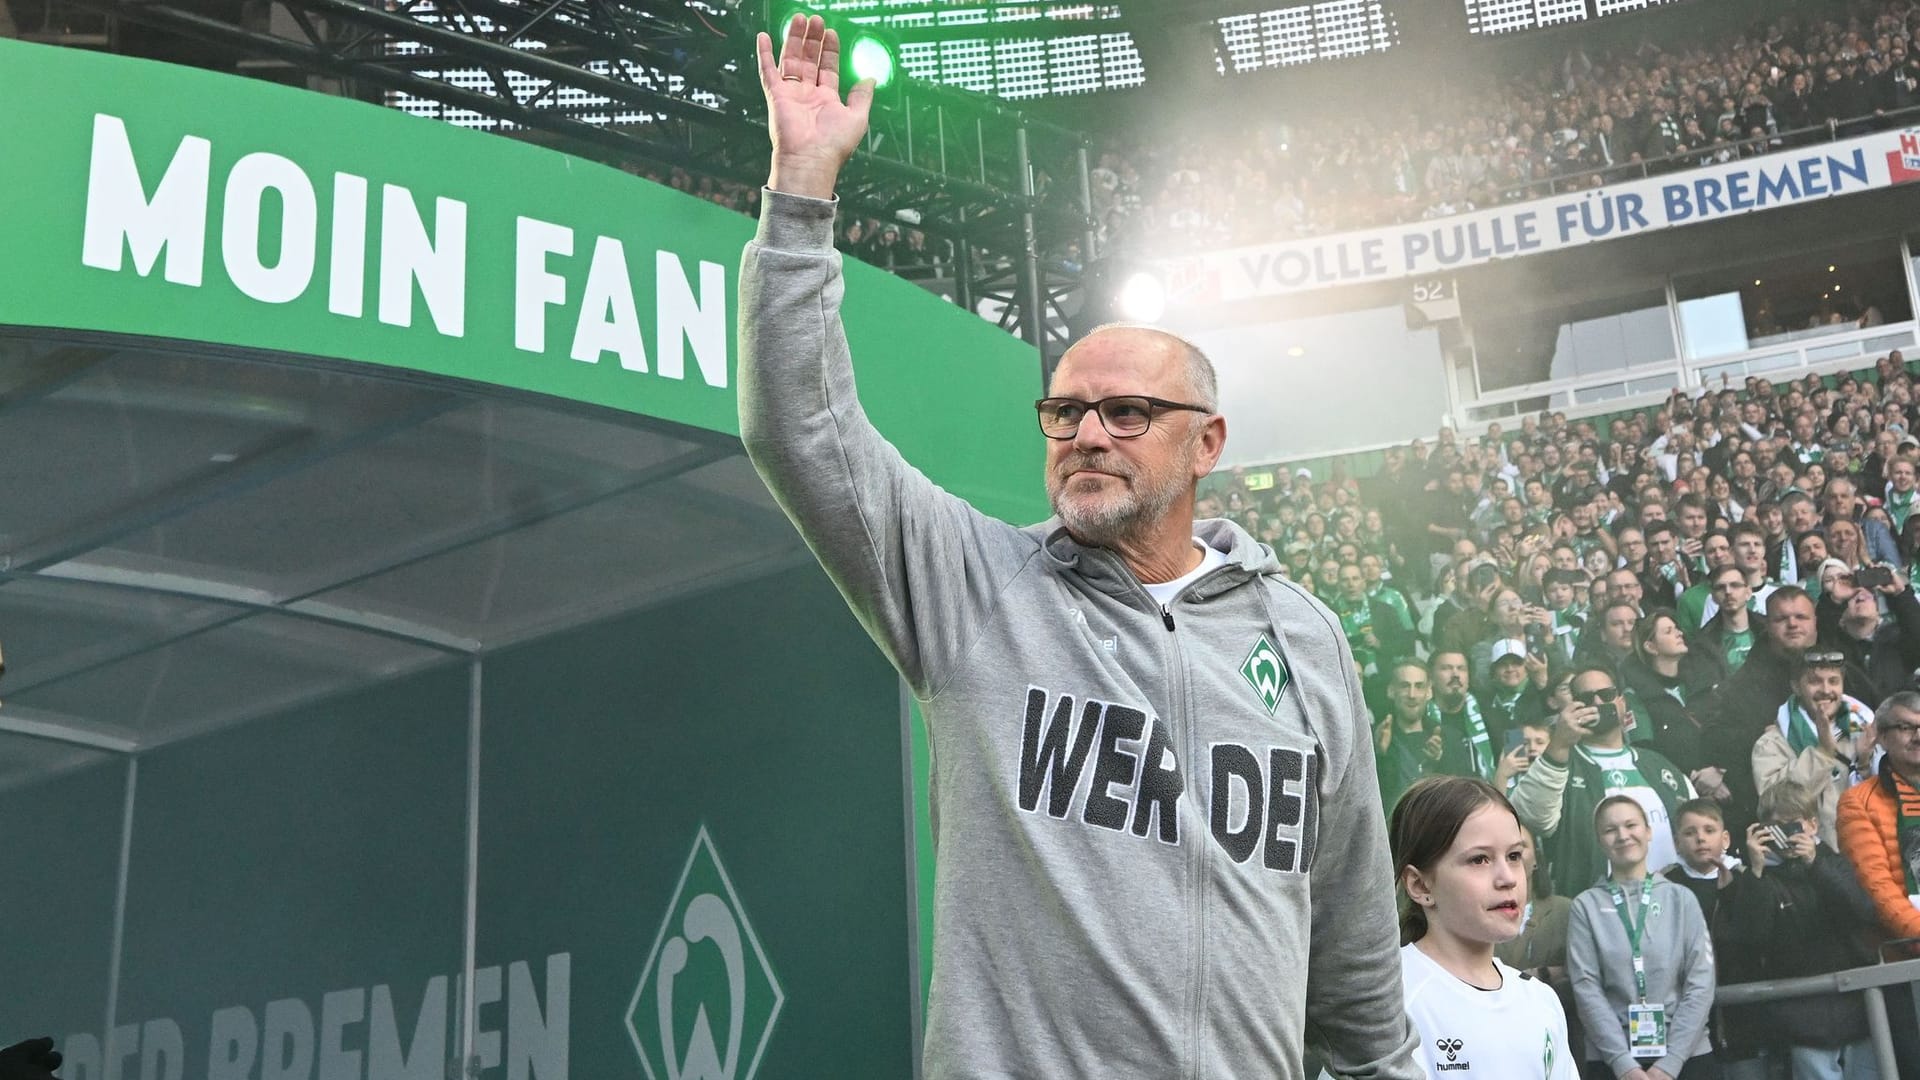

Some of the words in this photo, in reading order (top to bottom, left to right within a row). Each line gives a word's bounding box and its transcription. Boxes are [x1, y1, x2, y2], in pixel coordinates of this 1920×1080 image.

[82, 112, 467, 338] MOIN
[515, 215, 728, 388] FAN
[1239, 238, 1388, 288] VOLLE
[1402, 212, 1542, 271] PULLE
[1556, 190, 1649, 243] FÜR
[1662, 148, 1869, 222] BREMEN
[1413, 280, 1444, 301] 52
[1436, 1061, 1470, 1071] hummel
